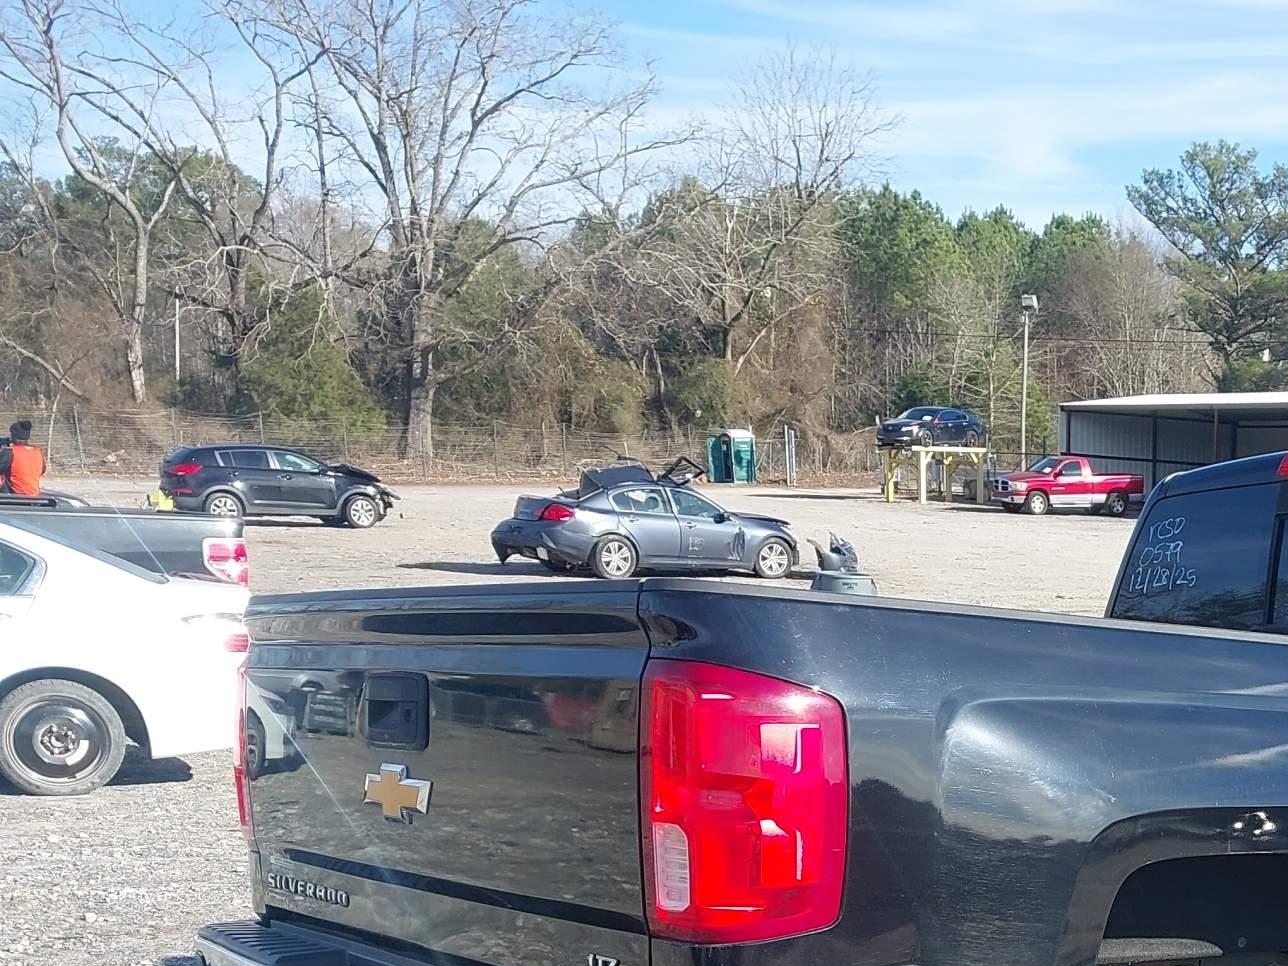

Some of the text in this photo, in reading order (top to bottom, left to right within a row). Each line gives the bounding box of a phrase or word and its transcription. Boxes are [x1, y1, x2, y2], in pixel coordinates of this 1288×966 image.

[1140, 541, 1183, 567] 0579
[1129, 563, 1197, 595] 12/28/25
[267, 872, 350, 908] SILVERADO
